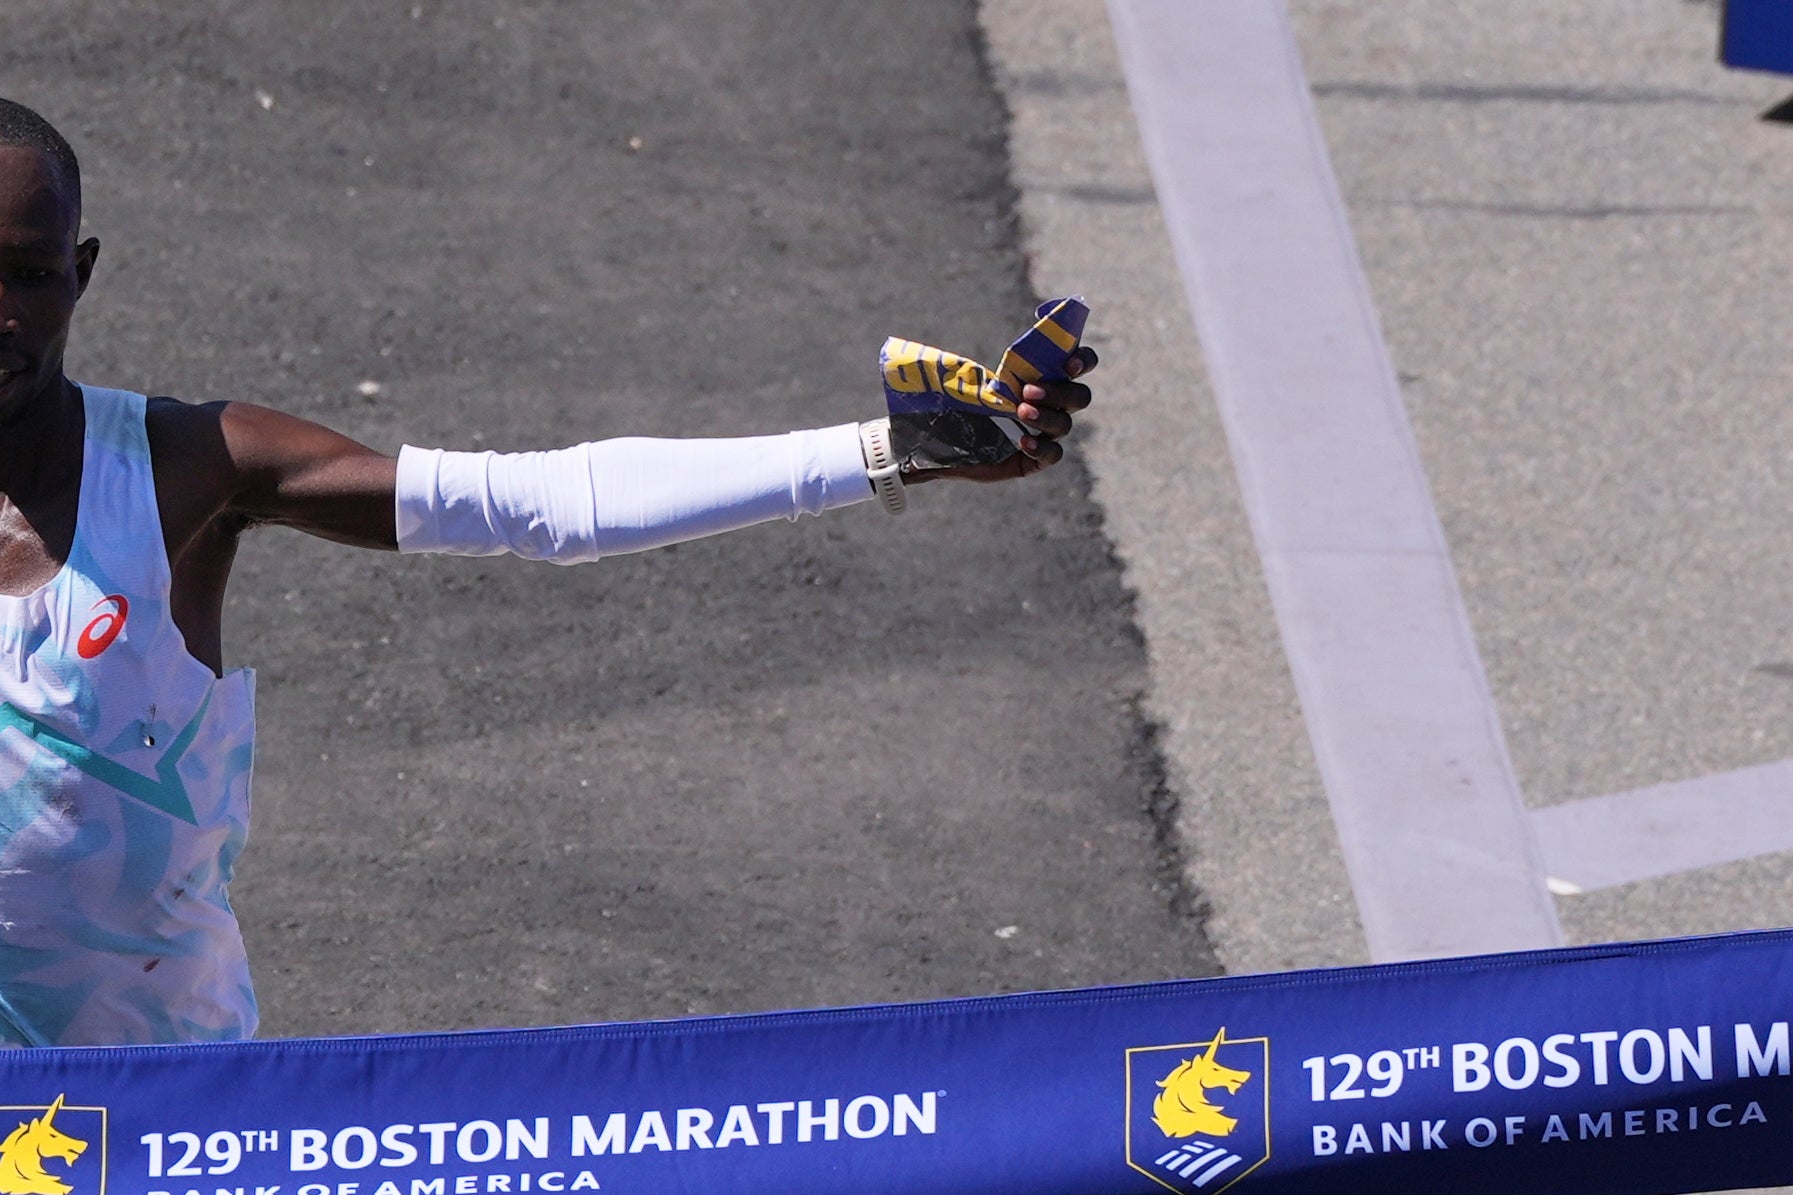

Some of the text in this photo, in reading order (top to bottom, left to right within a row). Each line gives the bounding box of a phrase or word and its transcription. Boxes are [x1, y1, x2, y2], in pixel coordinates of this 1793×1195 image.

[1302, 1045, 1441, 1102] 129TH
[1451, 1025, 1714, 1093] BOSTON
[140, 1091, 937, 1178] 129TH BOSTON MARATHON
[1312, 1101, 1767, 1156] BANK OF AMERICA
